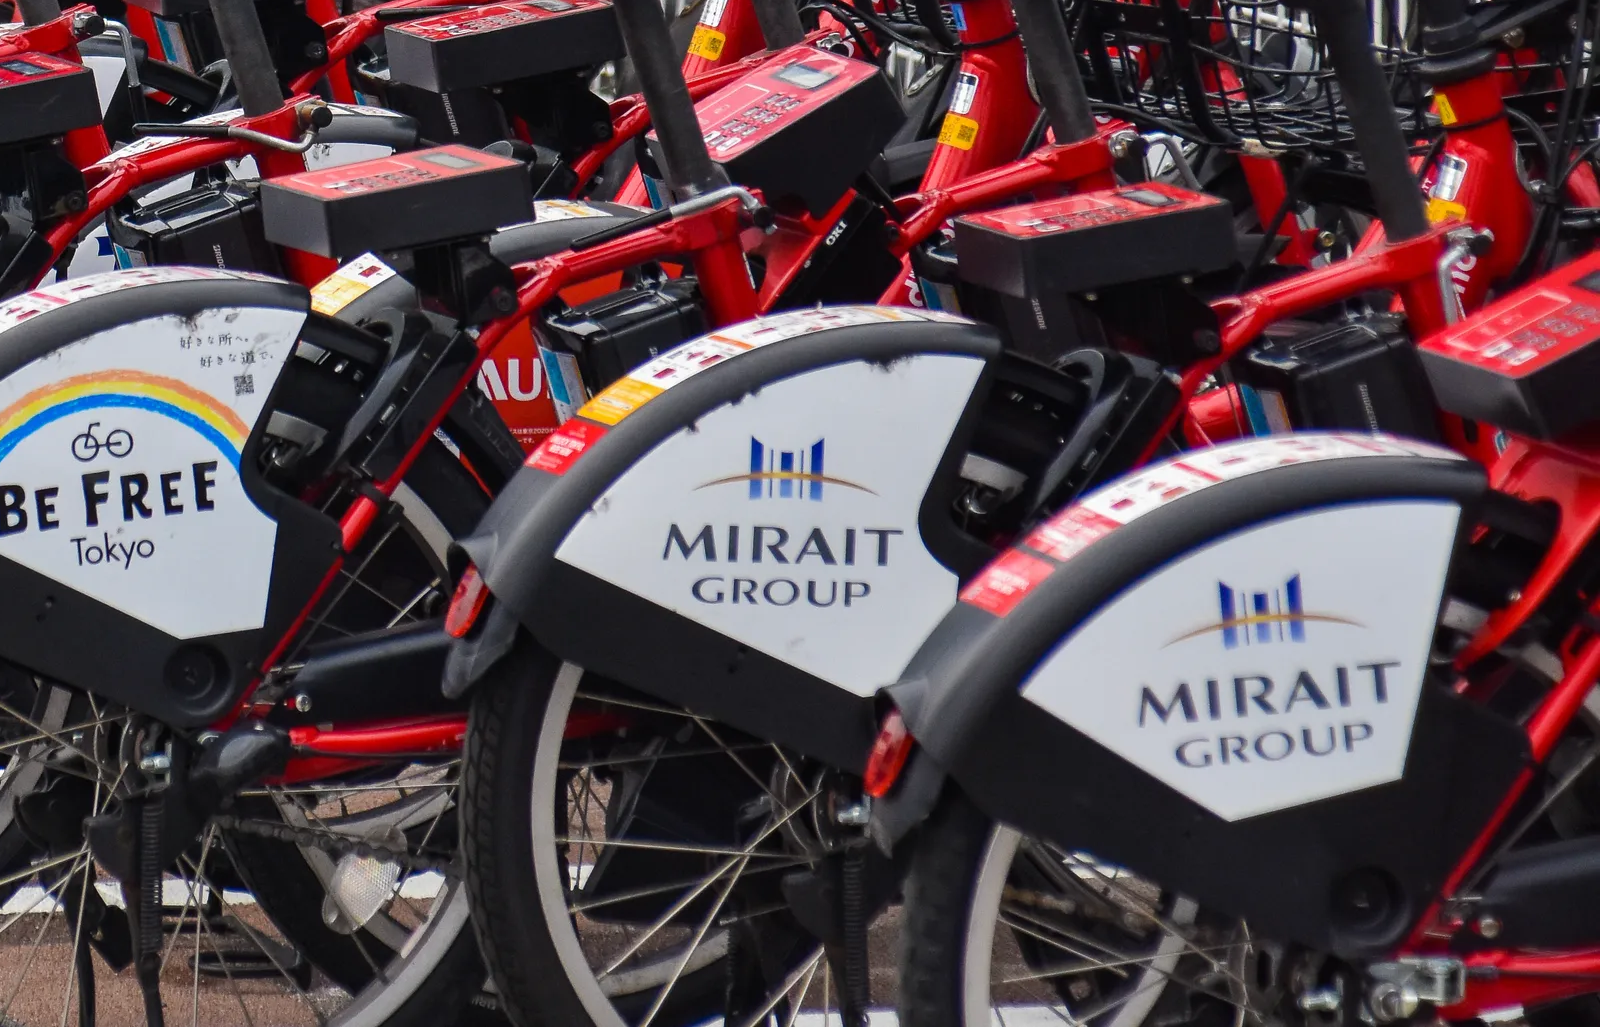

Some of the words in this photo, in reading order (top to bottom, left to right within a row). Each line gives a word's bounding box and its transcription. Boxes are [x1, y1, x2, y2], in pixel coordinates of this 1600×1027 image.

[825, 220, 847, 246] OKI
[70, 535, 155, 571] Tokyo
[662, 523, 903, 567] MIRAIT
[691, 577, 870, 608] GROUP
[1138, 660, 1400, 727] MIRAIT
[1175, 721, 1374, 768] GROUP
